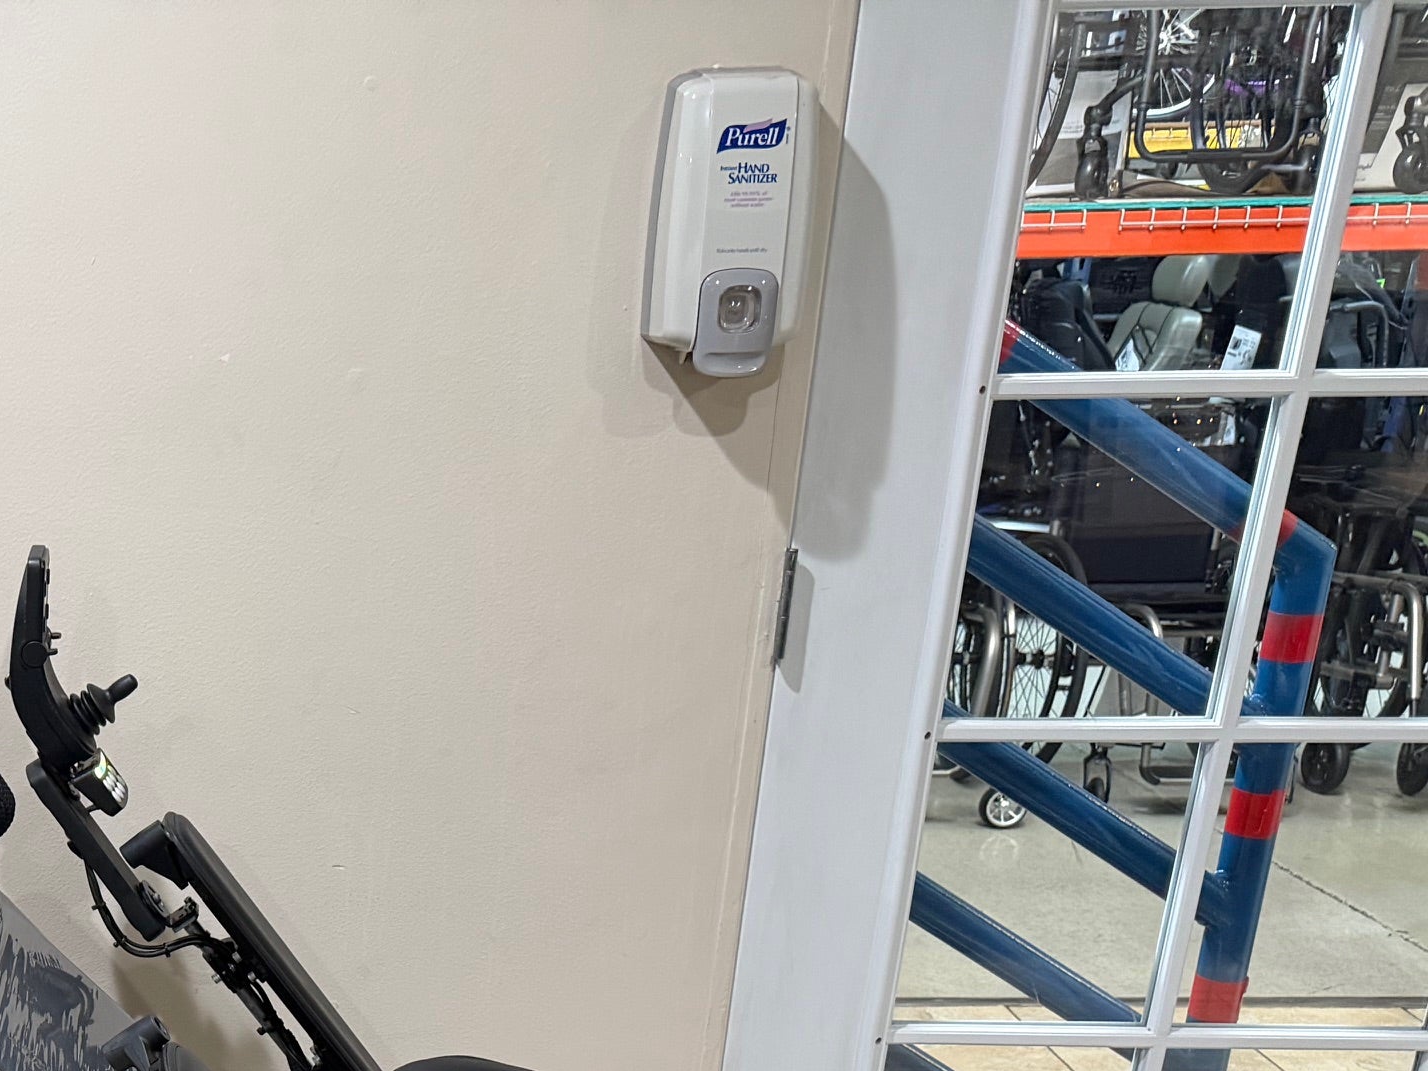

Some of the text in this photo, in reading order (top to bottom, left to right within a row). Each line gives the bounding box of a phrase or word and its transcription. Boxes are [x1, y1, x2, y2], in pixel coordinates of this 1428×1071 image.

[725, 127, 779, 146] Purell
[738, 162, 770, 173] HAND
[728, 172, 777, 184] SANITIZER
